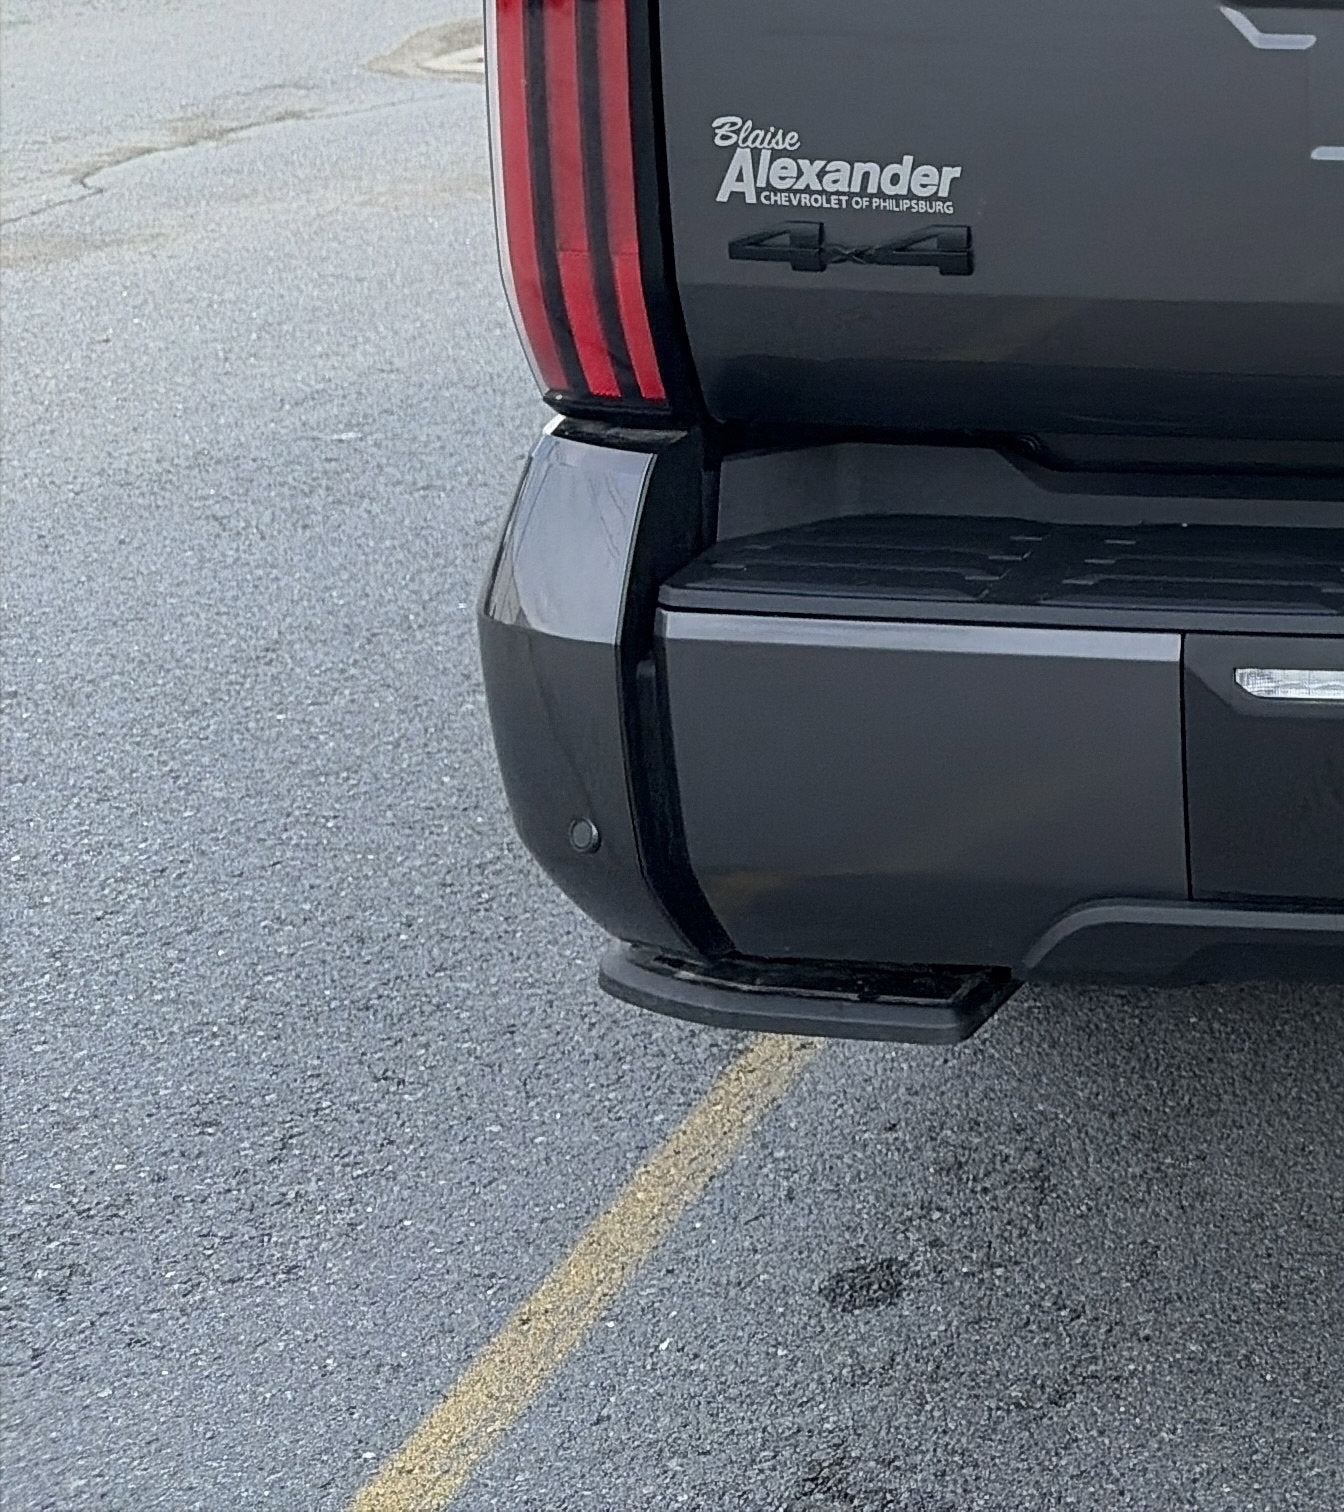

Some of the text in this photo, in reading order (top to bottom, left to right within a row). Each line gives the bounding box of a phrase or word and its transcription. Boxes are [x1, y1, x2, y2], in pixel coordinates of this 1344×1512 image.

[711, 115, 801, 150] Blaise
[715, 147, 962, 204] Alexander
[760, 191, 954, 214] CHEVROLET OF PHILIPSBURG
